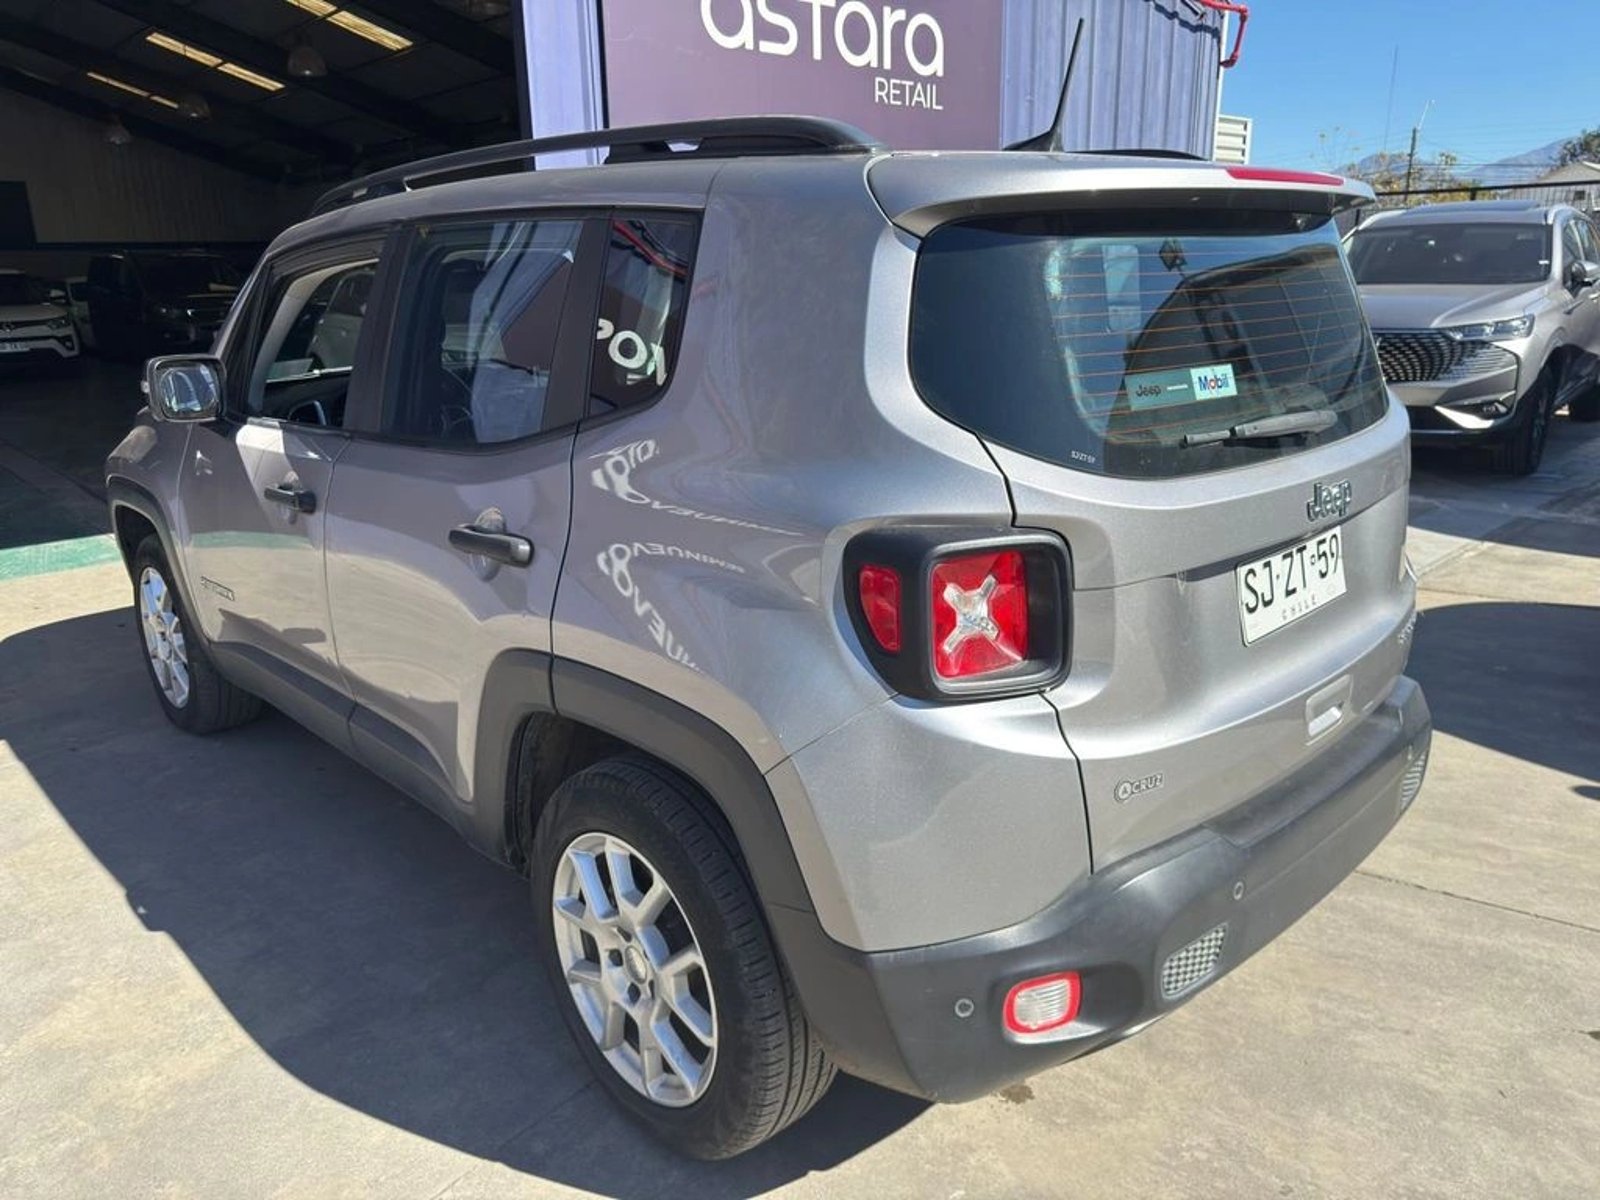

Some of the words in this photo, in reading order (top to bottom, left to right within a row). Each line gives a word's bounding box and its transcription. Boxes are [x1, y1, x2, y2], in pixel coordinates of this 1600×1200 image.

[874, 77, 944, 110] RETAIL
[1135, 385, 1162, 397] Jeep
[1198, 373, 1230, 391] Mobil
[1306, 481, 1351, 522] Jeep
